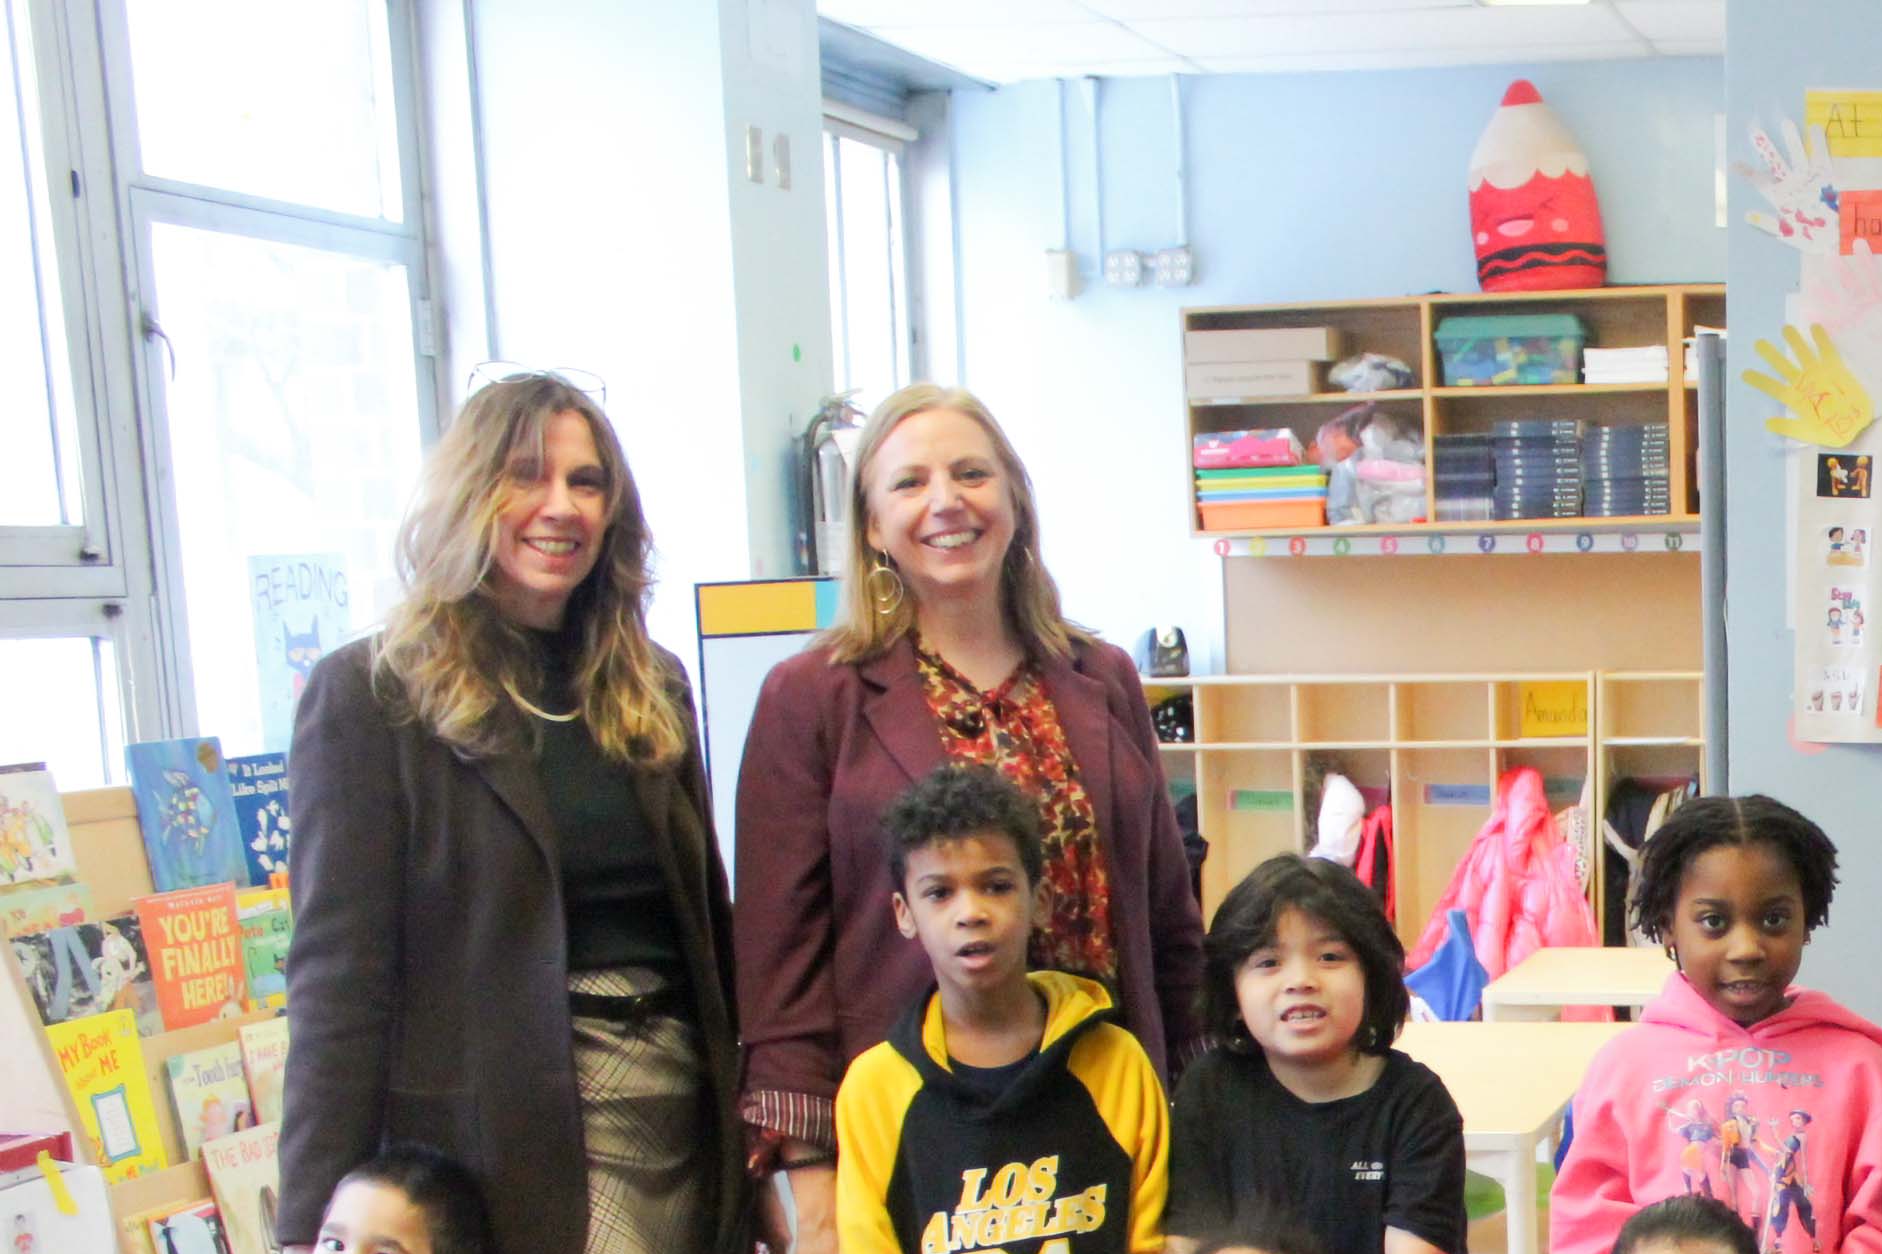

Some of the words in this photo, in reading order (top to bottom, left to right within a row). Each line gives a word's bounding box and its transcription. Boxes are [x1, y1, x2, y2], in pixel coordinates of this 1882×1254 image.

[1825, 103, 1862, 138] At
[254, 562, 349, 611] READING
[158, 906, 230, 945] YOU'RE
[160, 935, 237, 982] FINALLY
[57, 1046, 81, 1073] MY
[99, 1049, 121, 1077] ME
[953, 1154, 1060, 1216] LOS
